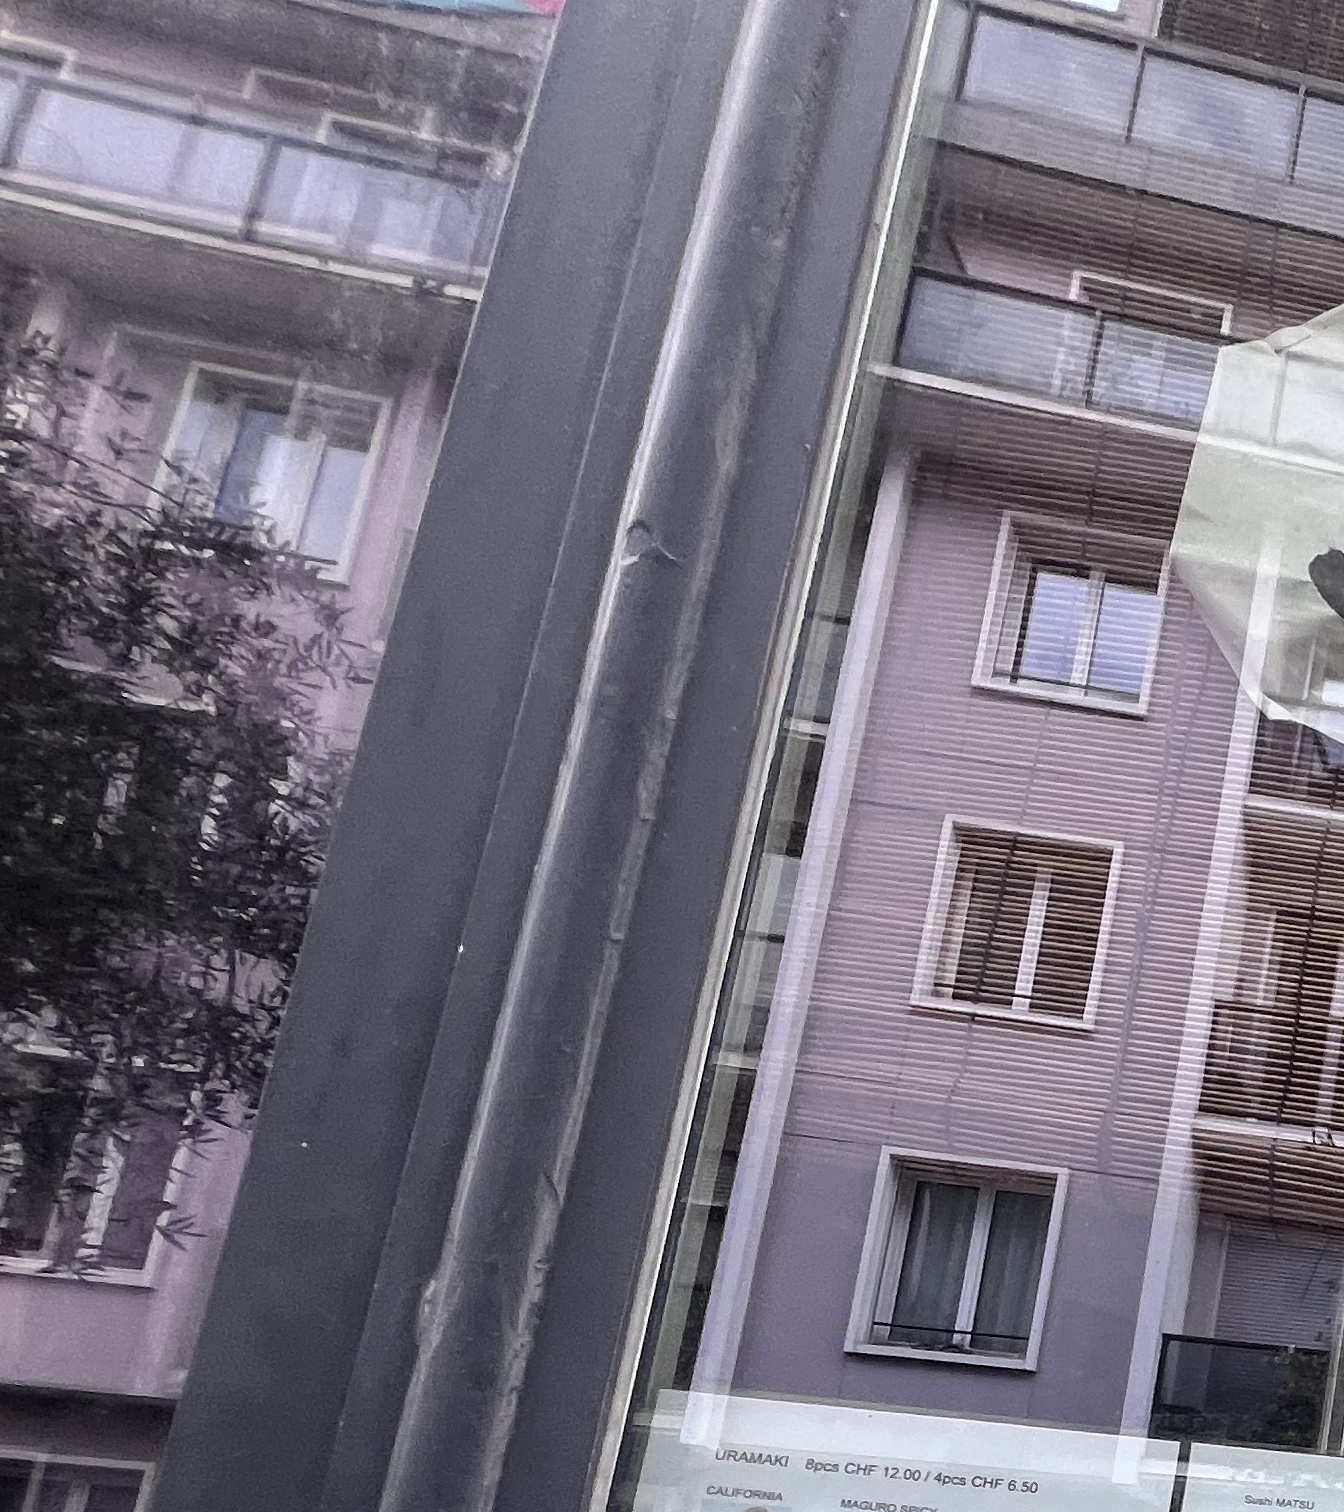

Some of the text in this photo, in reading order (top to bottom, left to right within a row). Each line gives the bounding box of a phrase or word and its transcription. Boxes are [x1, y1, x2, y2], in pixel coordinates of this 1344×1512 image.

[715, 1449, 1038, 1494] URAMAKI 8pcs CHF 12.00 4pcs CHF 6.50
[706, 1485, 783, 1501] CALIFORNIA
[840, 1499, 896, 1512] MAGURO
[1275, 1497, 1315, 1511] MATSU
